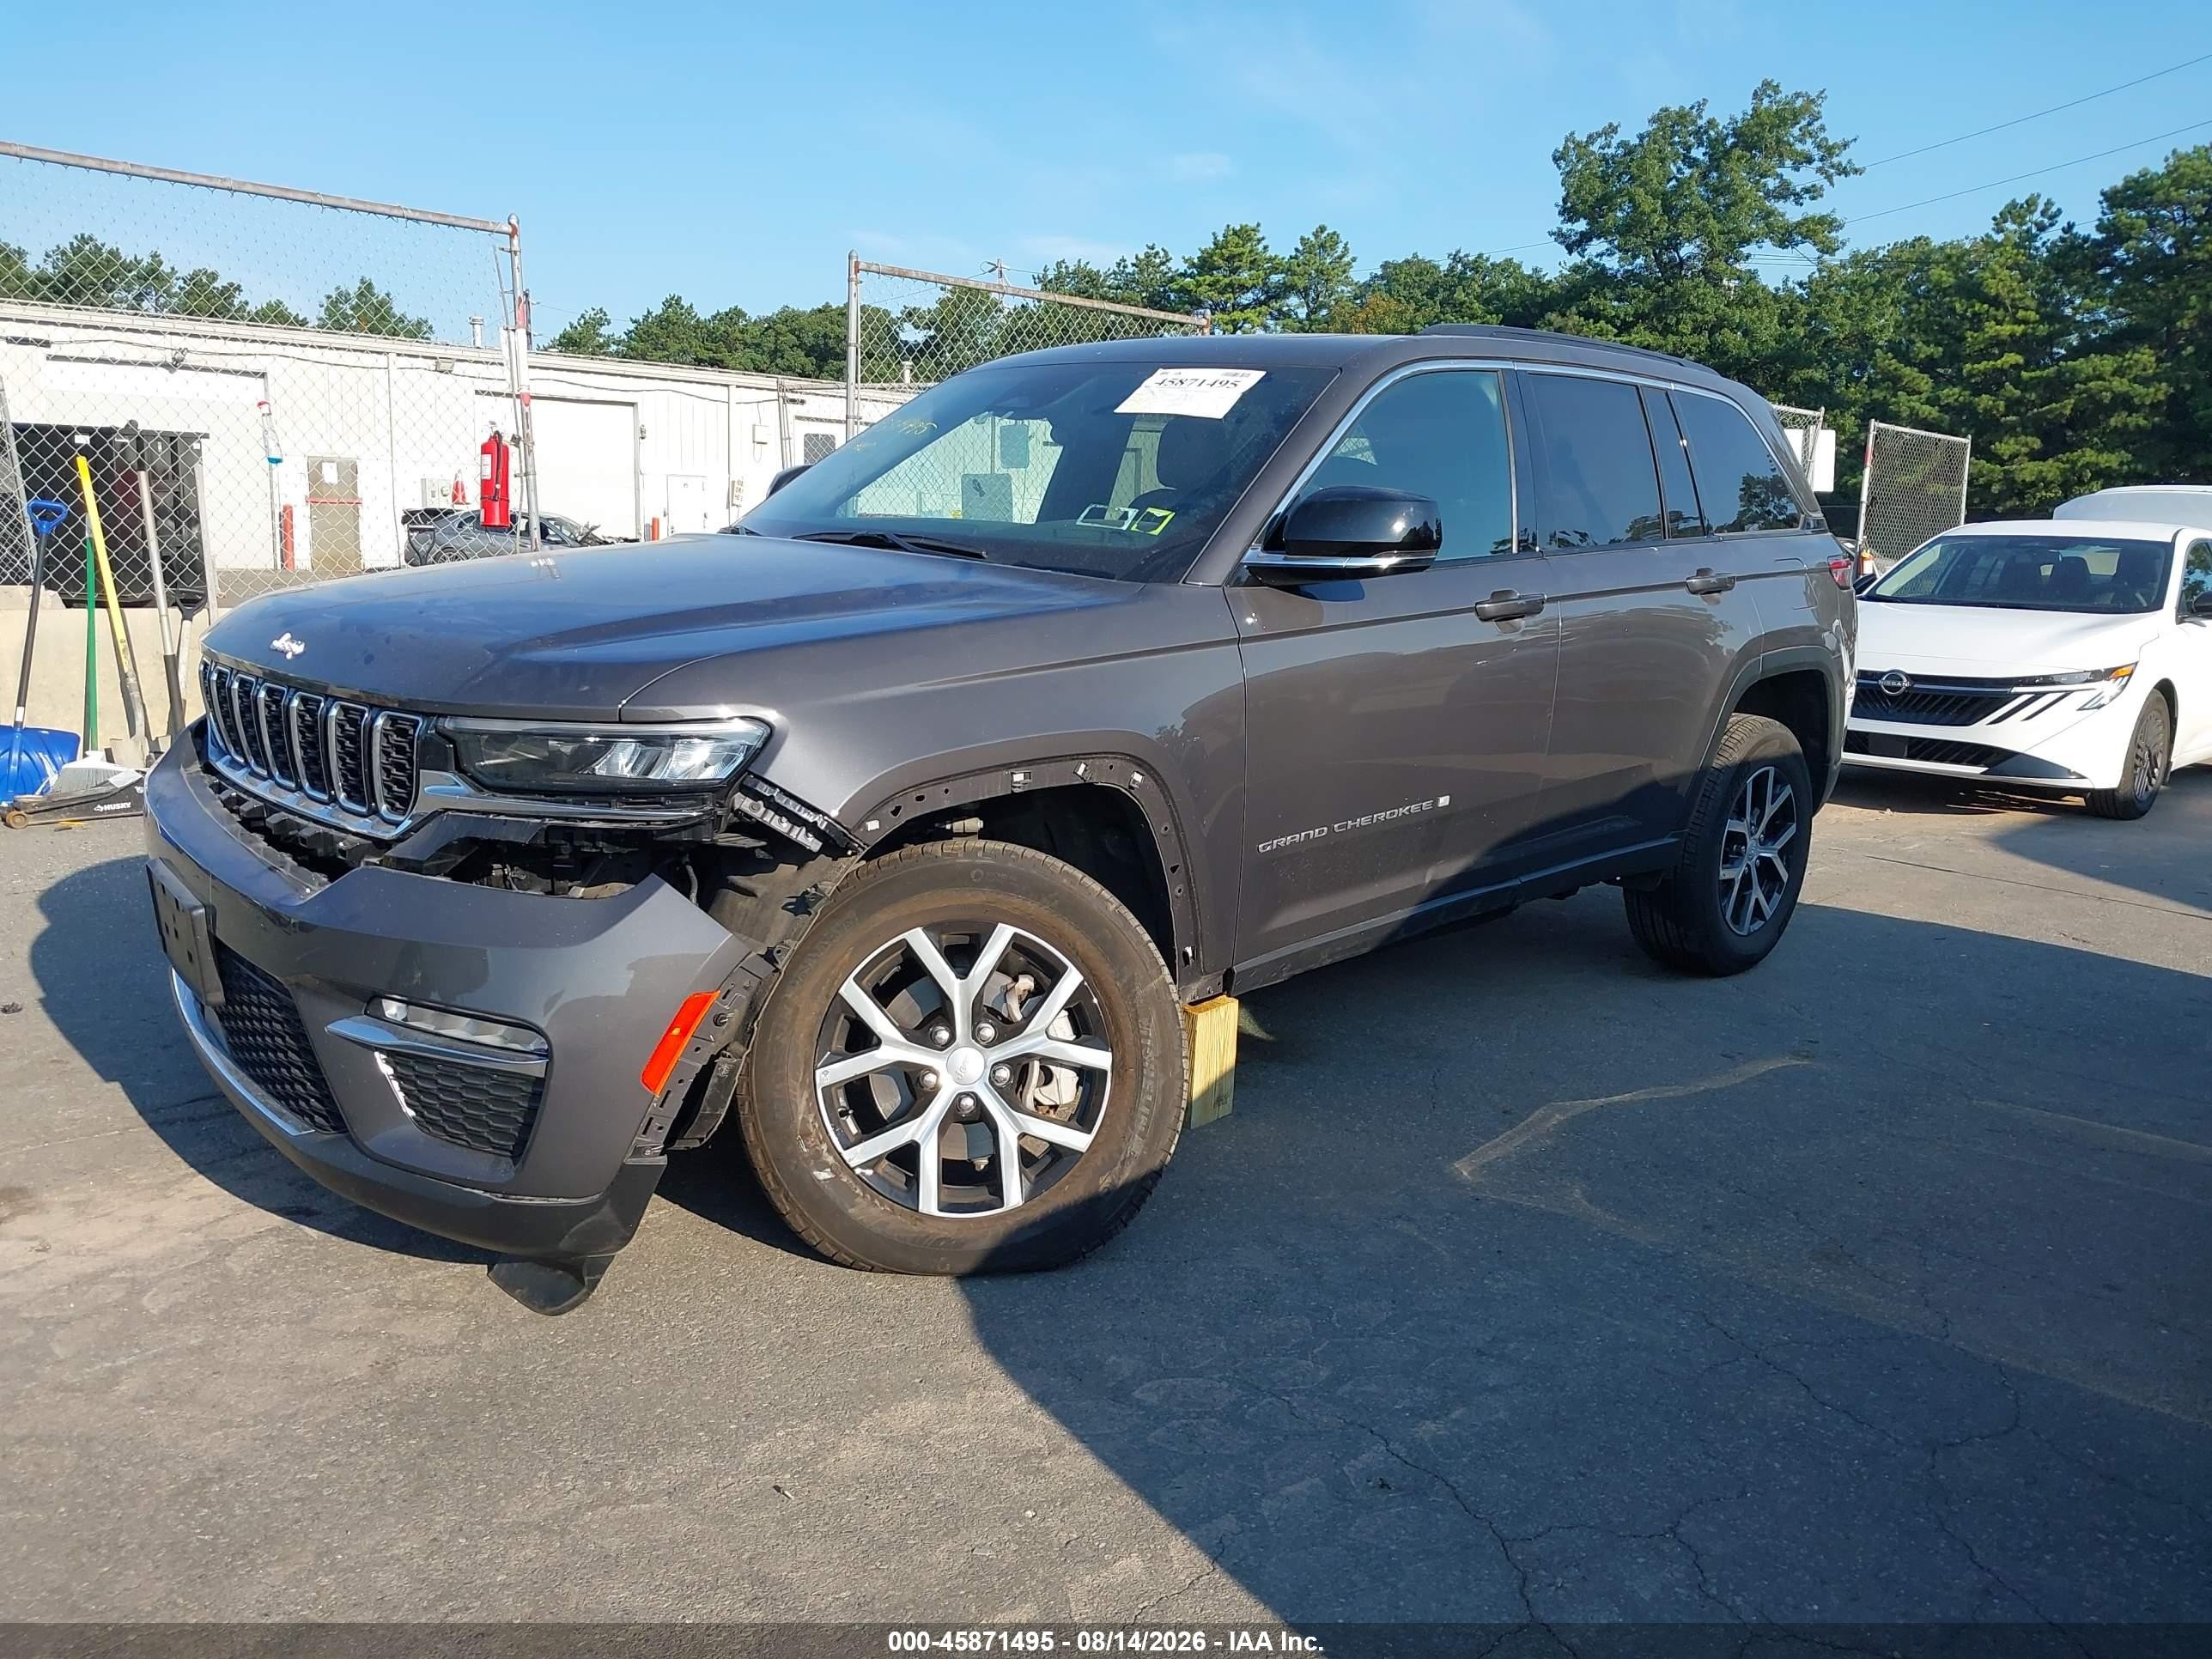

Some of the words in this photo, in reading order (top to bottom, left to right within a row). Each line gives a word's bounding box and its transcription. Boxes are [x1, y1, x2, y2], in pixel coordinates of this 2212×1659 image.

[1154, 378, 1242, 389] 45871495
[104, 802, 131, 811] HUSKY
[1257, 825, 1328, 854] GRAND
[1332, 799, 1435, 833] CHEROKEE
